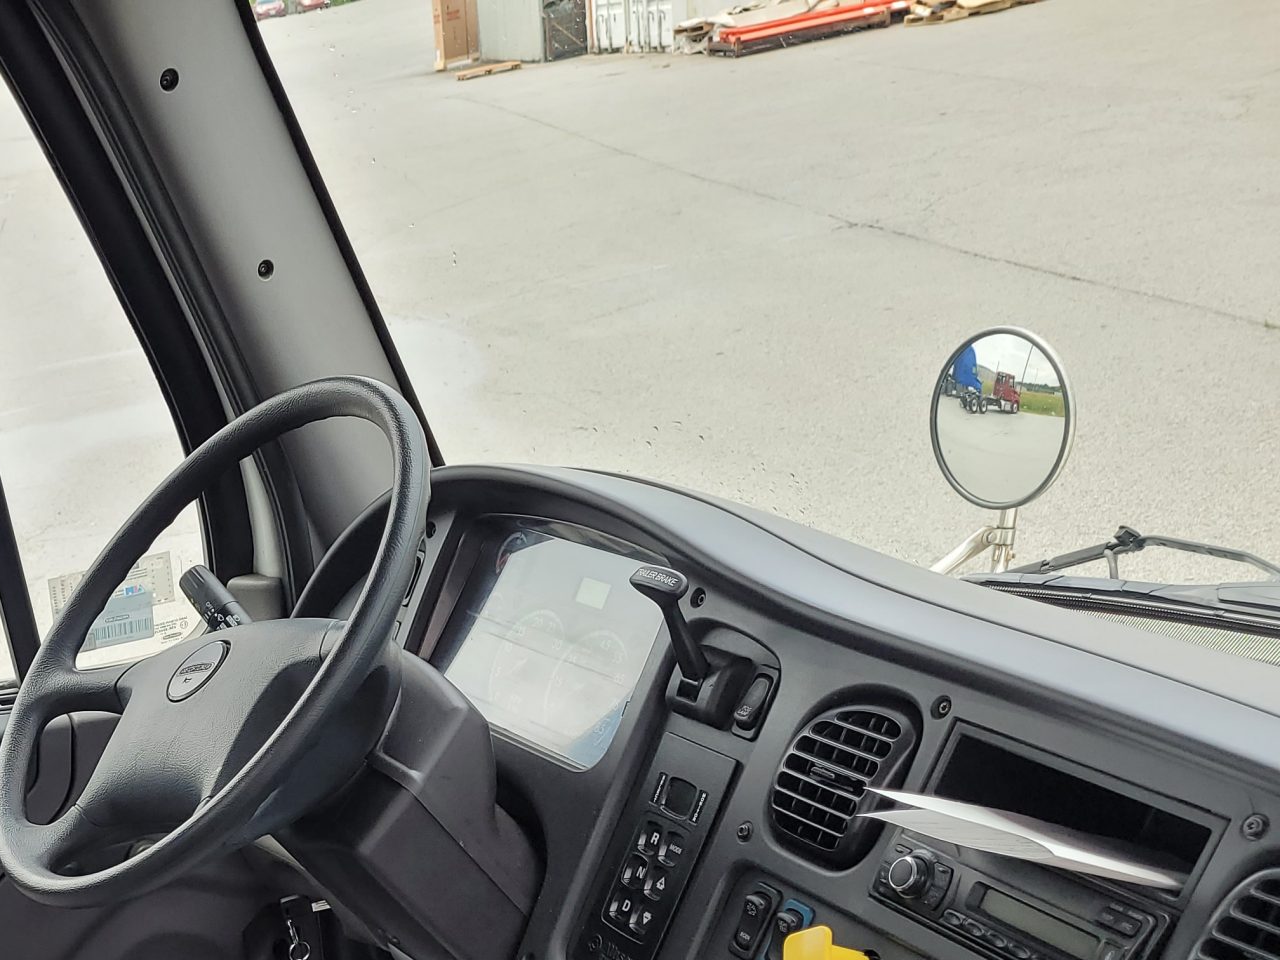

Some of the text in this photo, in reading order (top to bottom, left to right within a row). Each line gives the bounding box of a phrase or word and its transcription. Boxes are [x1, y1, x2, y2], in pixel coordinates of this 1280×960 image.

[655, 572, 678, 586] BRAKE
[650, 832, 660, 845] R
[636, 866, 647, 879] N
[622, 899, 631, 912] D
